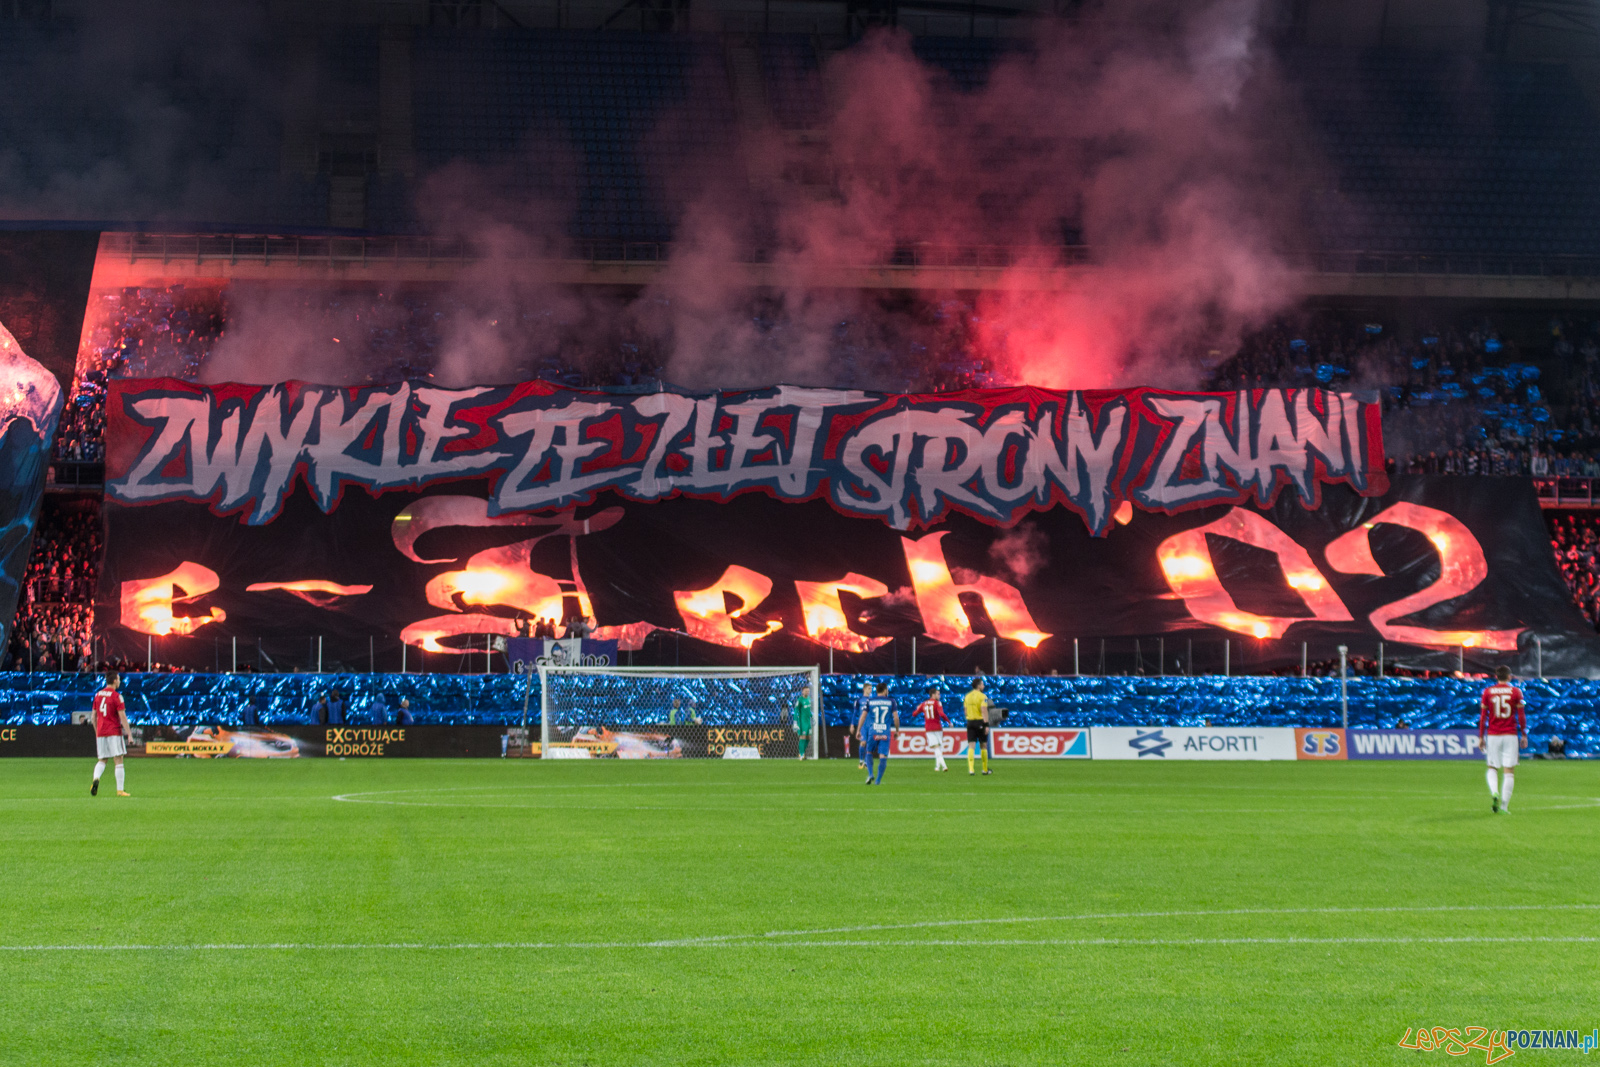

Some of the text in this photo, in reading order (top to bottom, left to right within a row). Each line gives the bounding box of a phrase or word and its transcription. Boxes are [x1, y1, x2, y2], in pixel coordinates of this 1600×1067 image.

[497, 397, 642, 508] ZE
[836, 390, 1126, 531] STRONY
[1132, 387, 1364, 502] ZNANI
[99, 696, 107, 717] 4
[872, 706, 889, 723] 17
[923, 704, 935, 719] 11
[1491, 695, 1512, 718] 15
[325, 728, 405, 744] EXCYTUJĄCE
[707, 728, 785, 744] EXCYTUJĄCE
[998, 733, 1058, 753] tesa
[1183, 735, 1258, 752] AFORTI
[1303, 731, 1341, 757] STS
[1353, 734, 1485, 755] WWW.STS.P
[325, 742, 384, 756] PODRÓŻE
